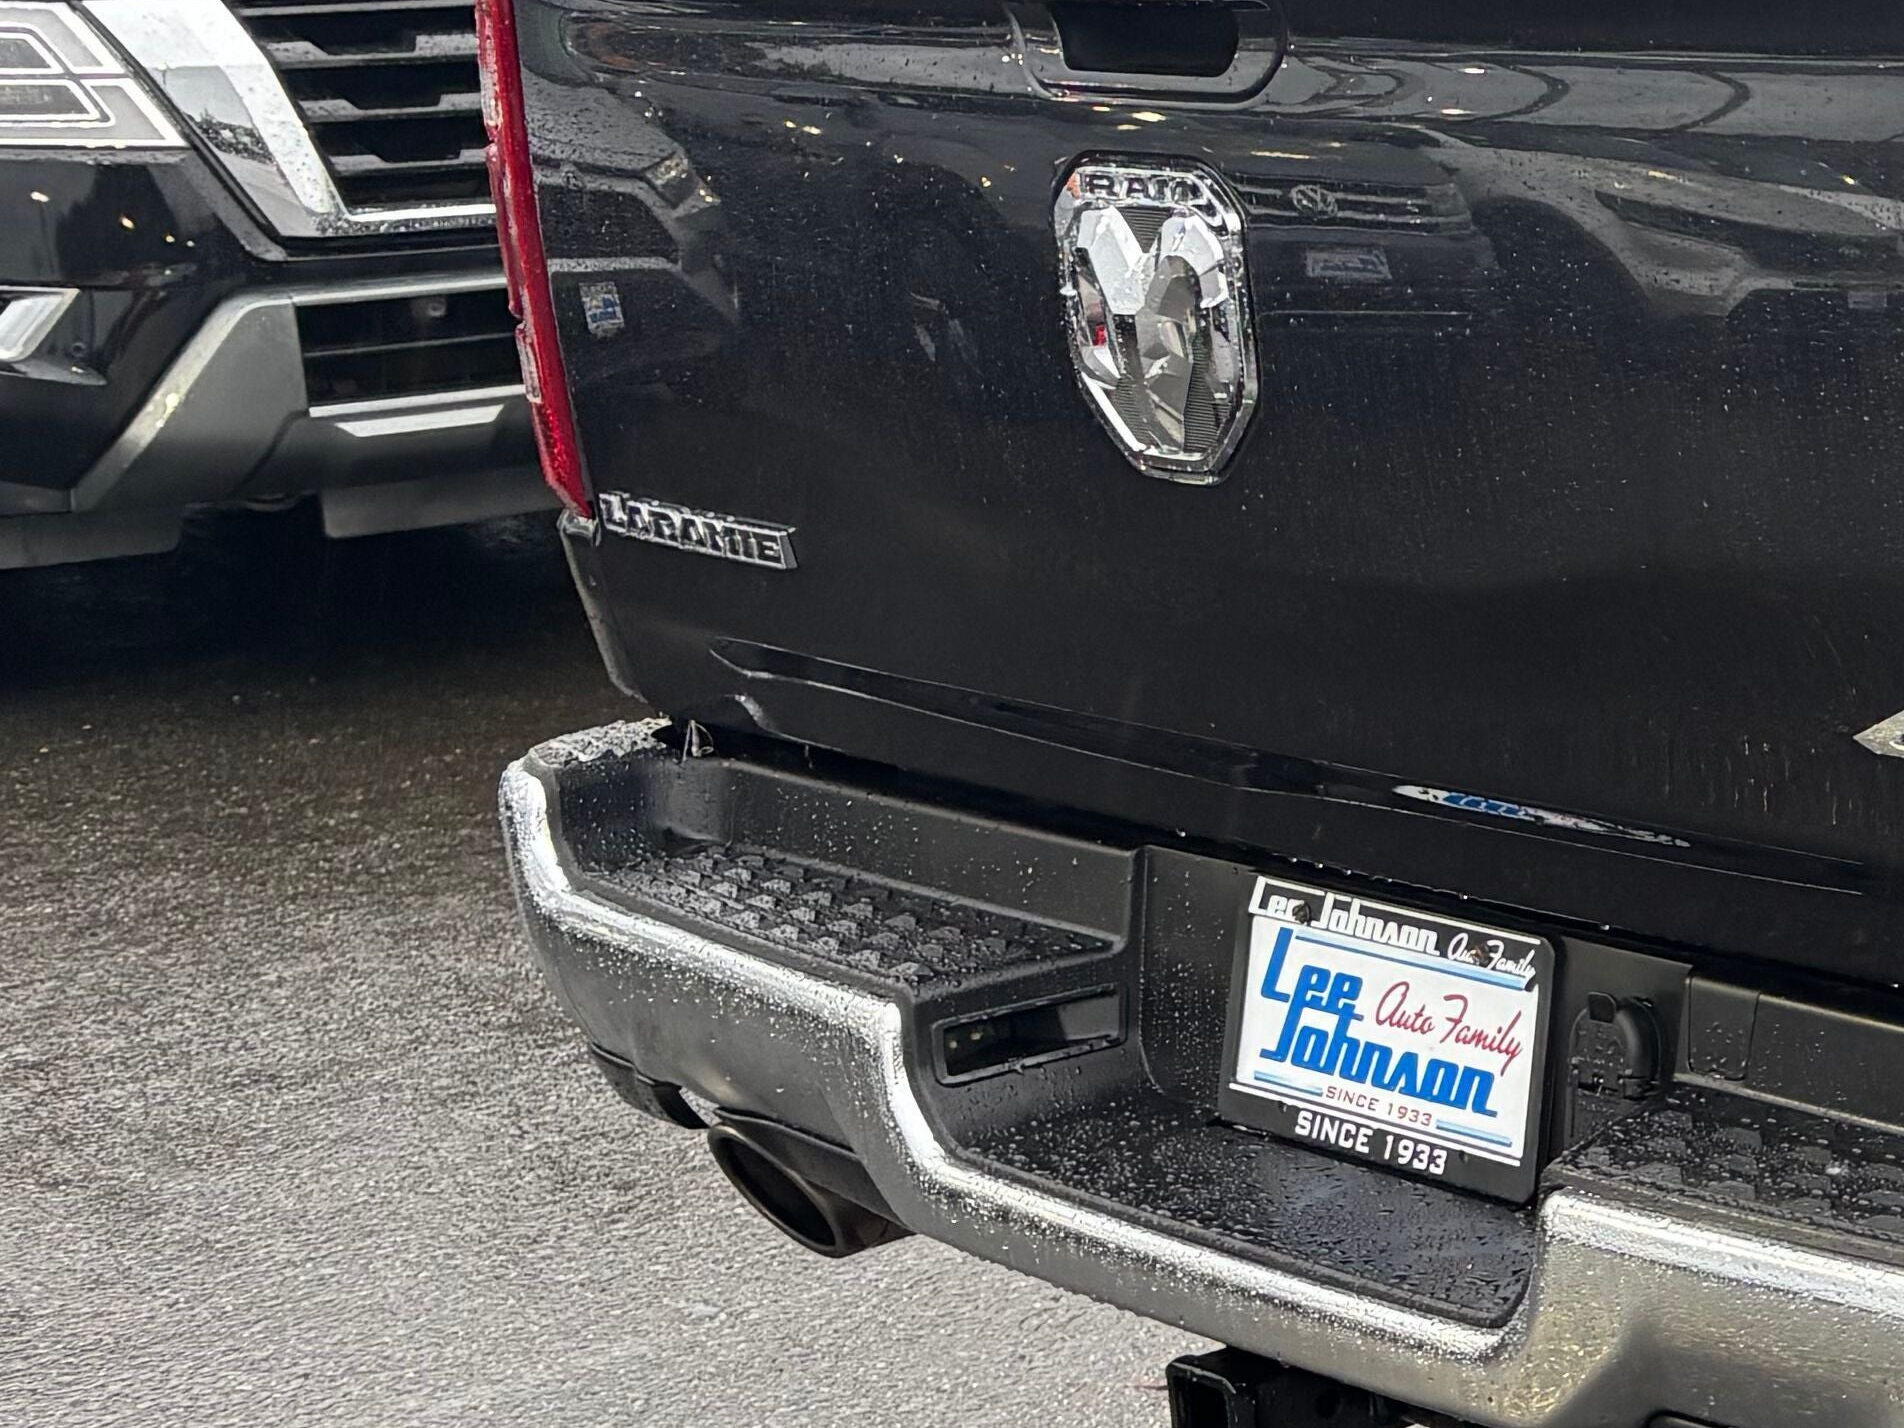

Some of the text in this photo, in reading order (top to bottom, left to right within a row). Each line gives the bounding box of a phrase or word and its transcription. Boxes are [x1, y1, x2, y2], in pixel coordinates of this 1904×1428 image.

[1083, 173, 1202, 203] RAM
[599, 491, 798, 570] LARAMIE
[1261, 926, 1364, 1013] Lee
[1310, 892, 1441, 957] Johnson
[1447, 932, 1484, 966] Au
[1486, 939, 1537, 991] Family
[1259, 1009, 1498, 1118] Johnson
[1375, 980, 1524, 1076] Auto Family
[1294, 1109, 1448, 1176] SINCE 1933
[1324, 1085, 1433, 1127] SINCE 1933
